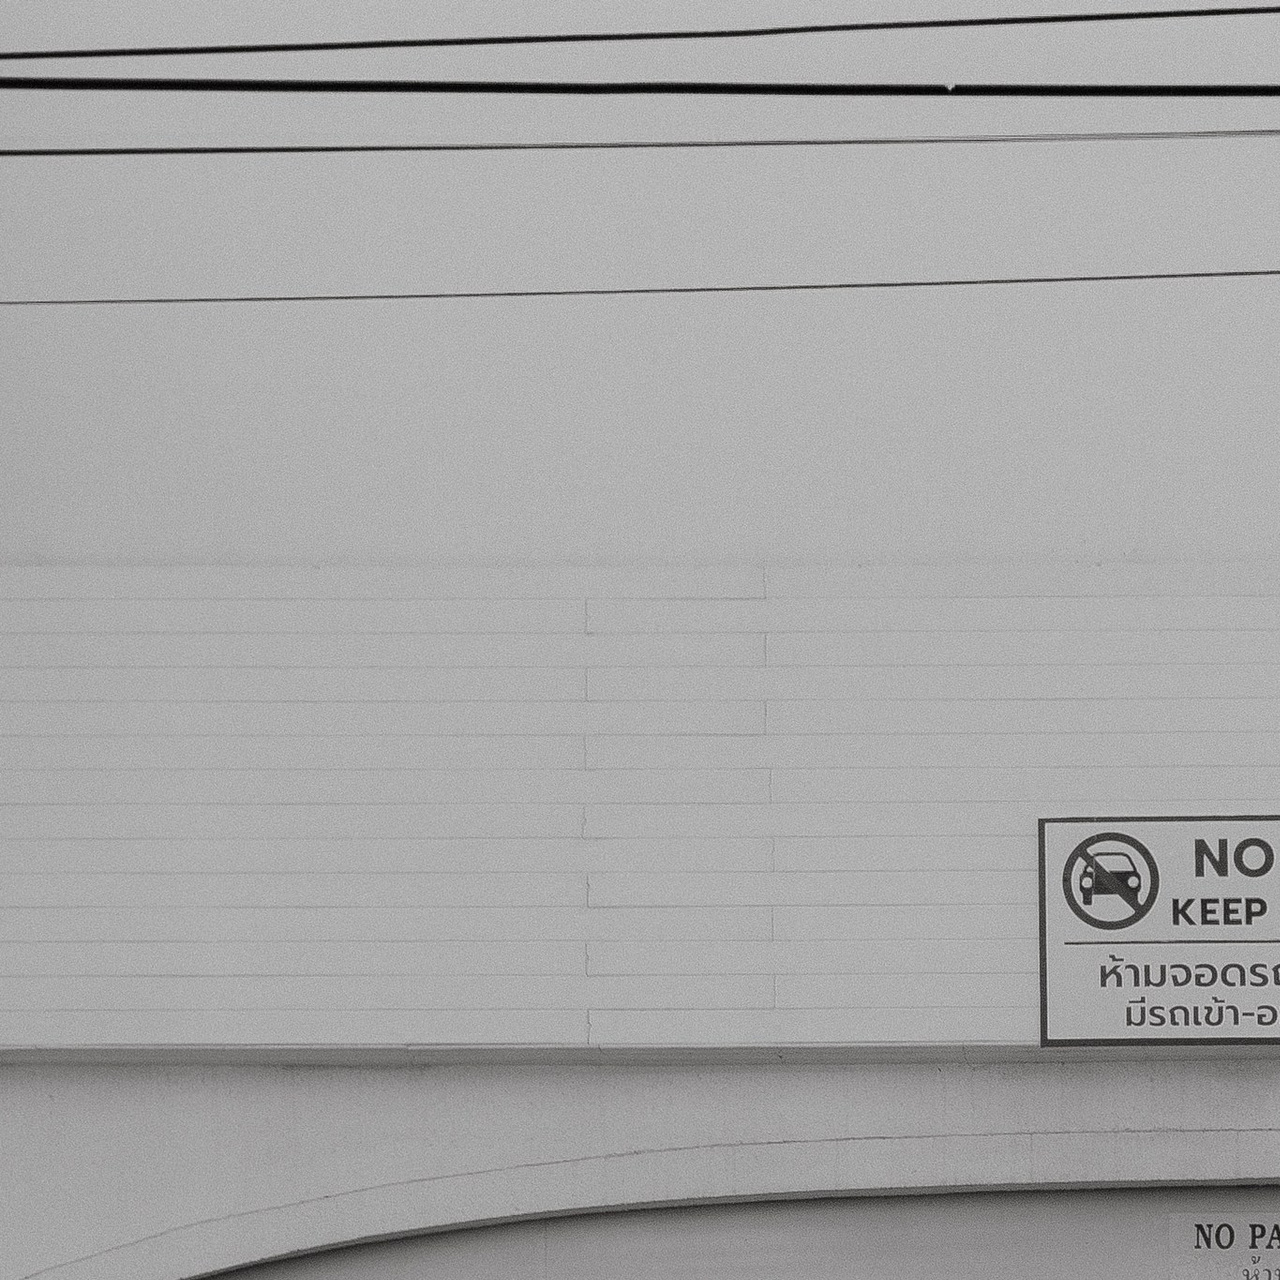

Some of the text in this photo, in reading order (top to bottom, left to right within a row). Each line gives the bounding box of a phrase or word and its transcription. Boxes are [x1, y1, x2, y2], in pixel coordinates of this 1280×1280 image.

[1194, 837, 1274, 878] NO
[1172, 897, 1268, 926] KEEP
[1194, 1223, 1235, 1250] NO
